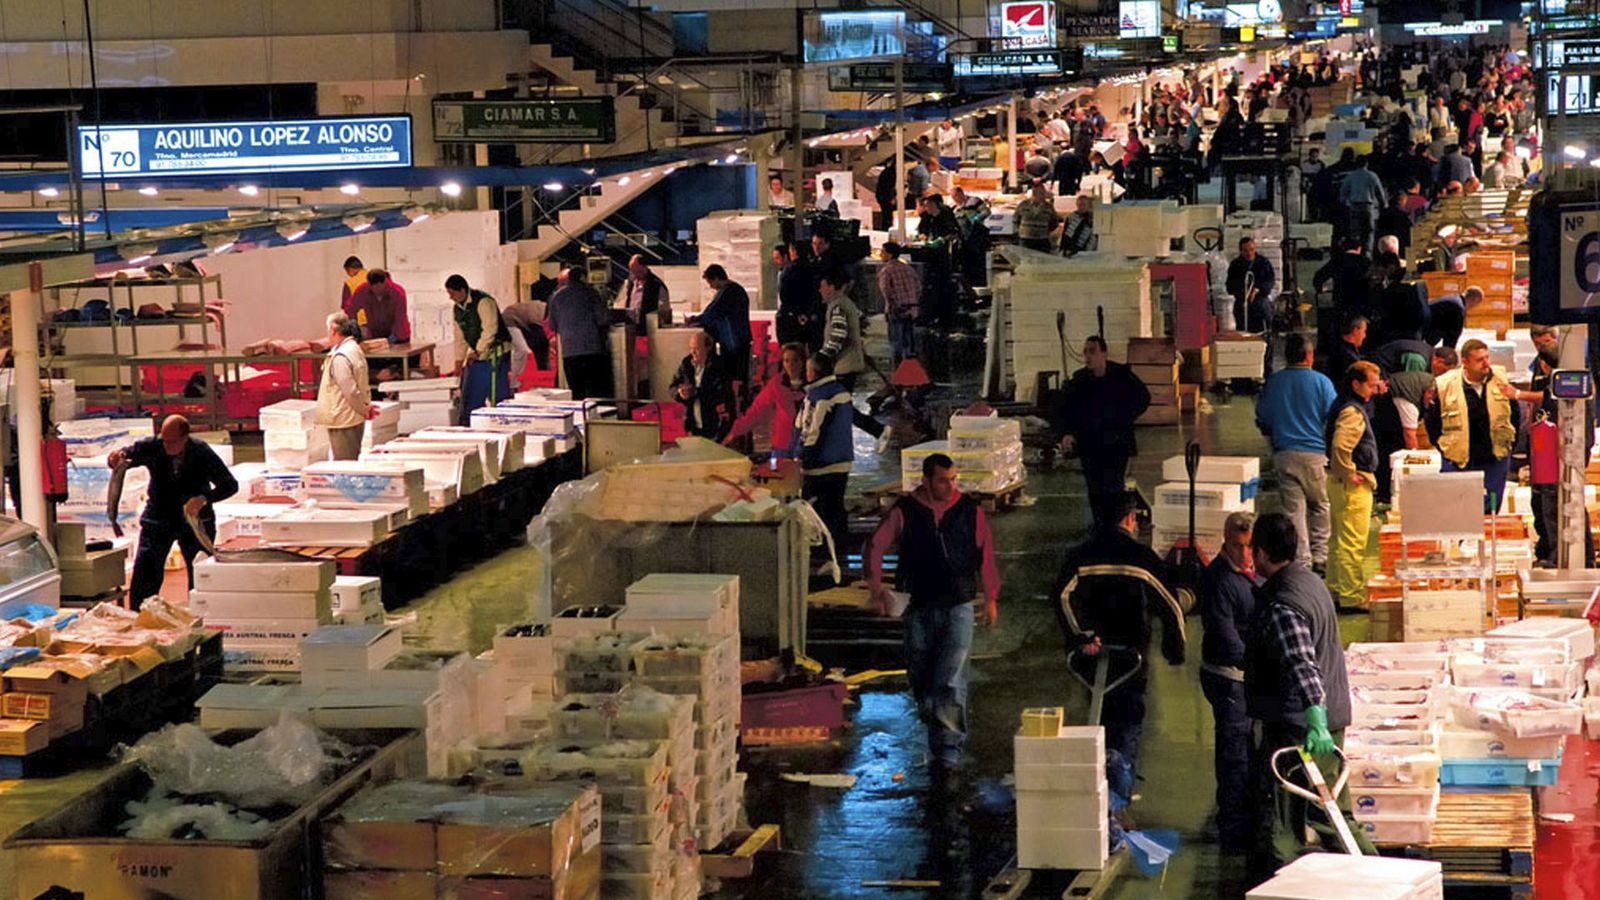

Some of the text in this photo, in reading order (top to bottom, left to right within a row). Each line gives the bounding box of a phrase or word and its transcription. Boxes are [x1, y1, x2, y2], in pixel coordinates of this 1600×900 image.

[483, 107, 545, 121] CIAMAR
[154, 123, 393, 149] AQUILINO LOPEZ ALONSO
[180, 150, 238, 159] Mercamadrid
[363, 145, 394, 153] Central
[110, 151, 136, 167] 70
